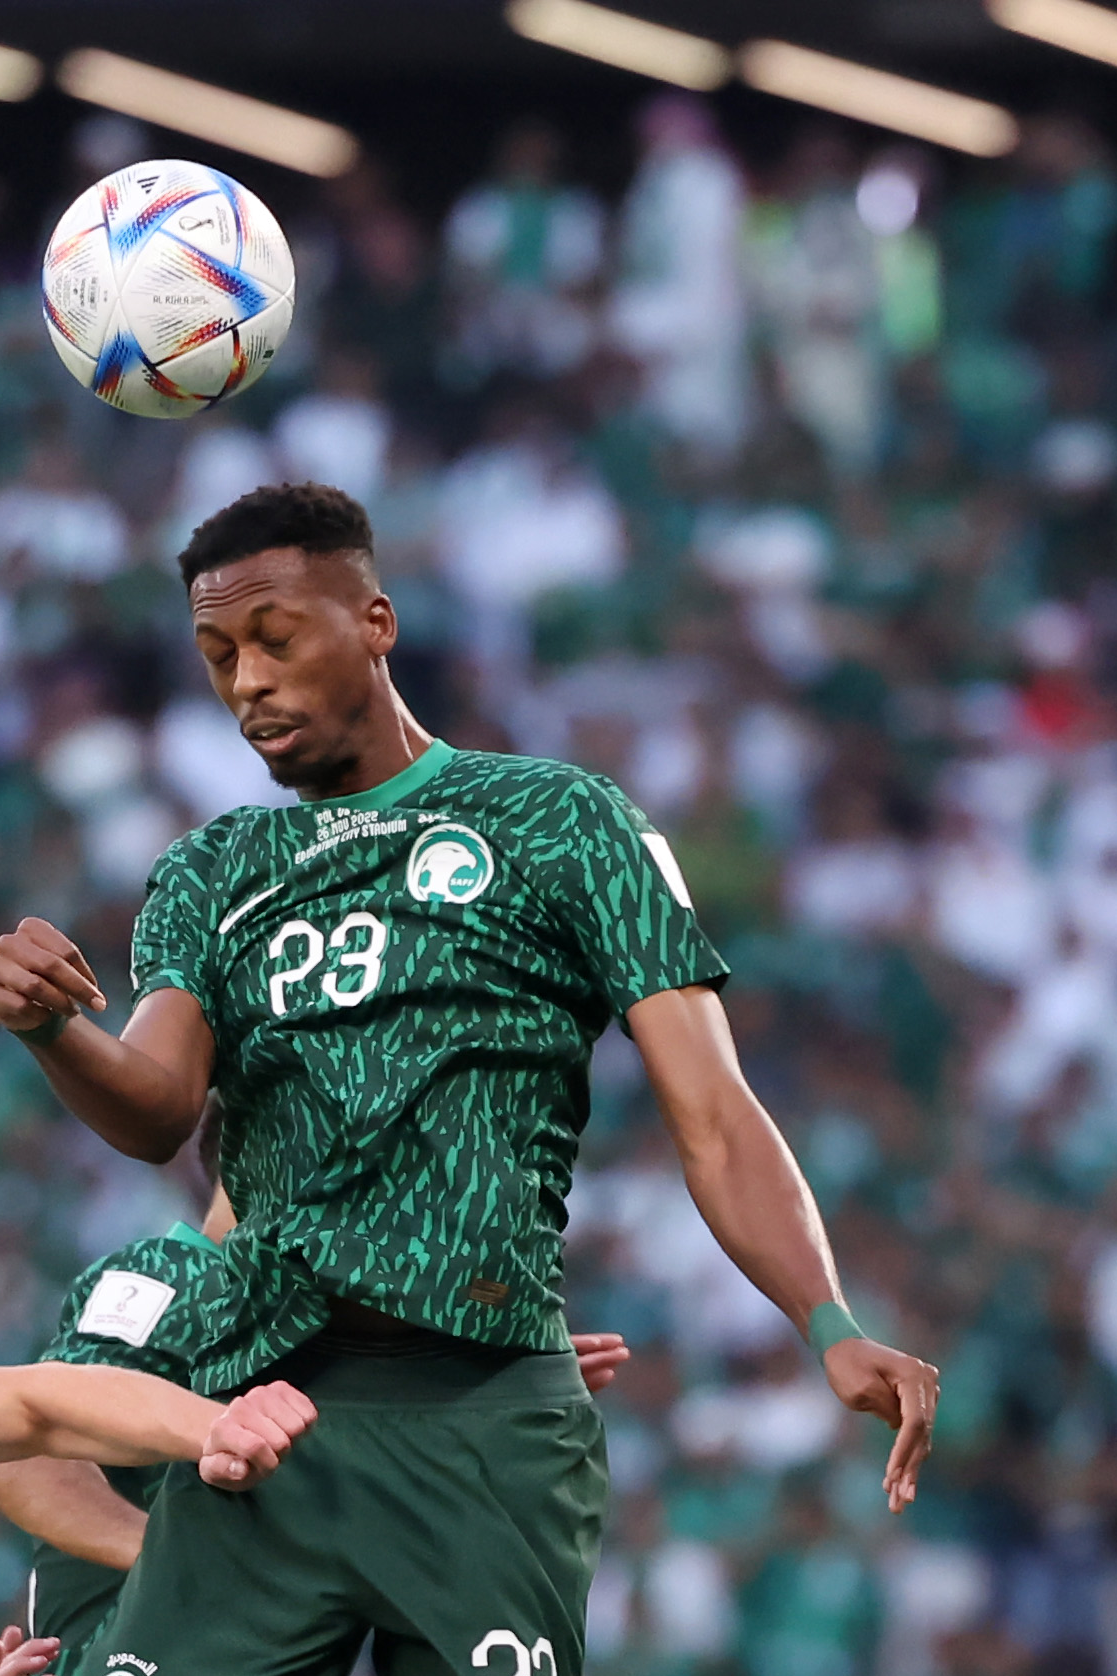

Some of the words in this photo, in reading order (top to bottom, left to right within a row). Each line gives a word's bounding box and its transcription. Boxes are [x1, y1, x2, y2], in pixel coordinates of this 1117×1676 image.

[316, 809, 335, 826] POL
[316, 826, 329, 841] 26
[331, 817, 349, 836] NOV
[350, 810, 379, 827] 2022
[295, 835, 340, 865] EDUCATION
[341, 826, 360, 843] CITY
[361, 819, 407, 838] STADIUM
[449, 877, 475, 888] SAFF
[268, 911, 387, 1017] 23
